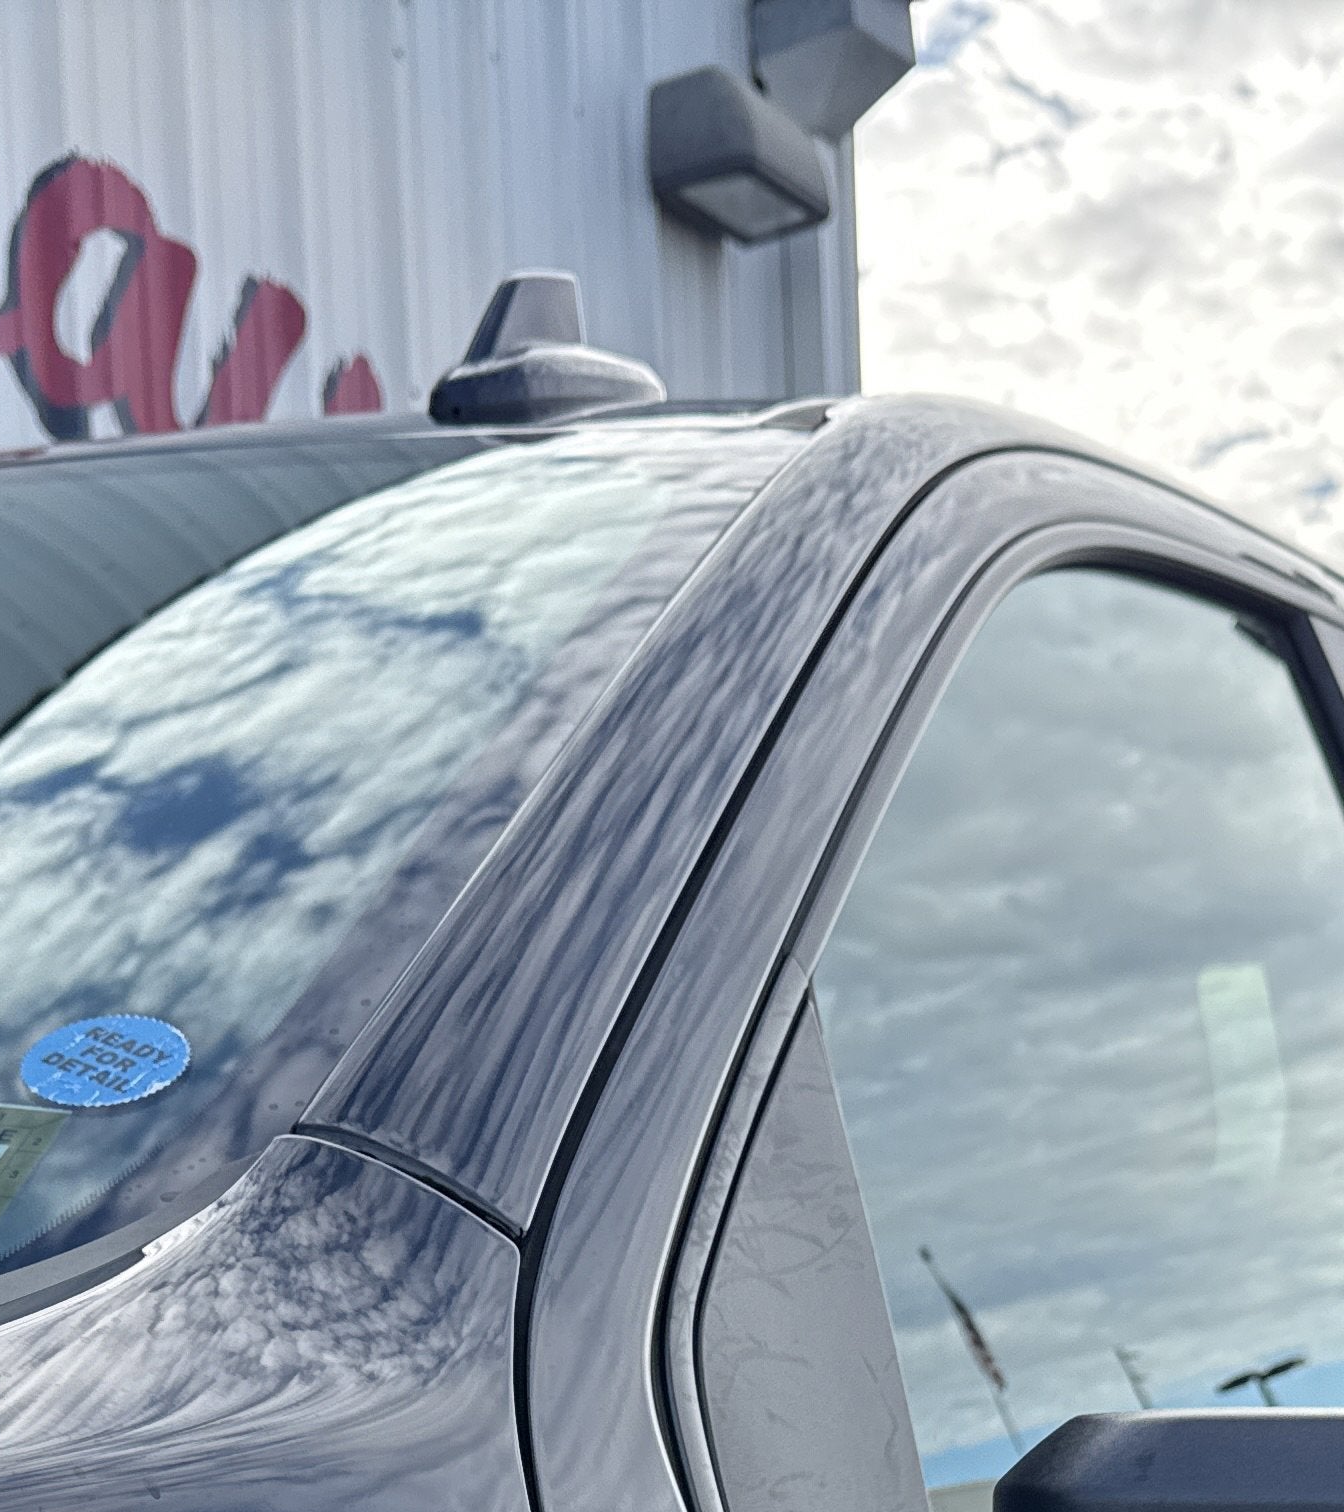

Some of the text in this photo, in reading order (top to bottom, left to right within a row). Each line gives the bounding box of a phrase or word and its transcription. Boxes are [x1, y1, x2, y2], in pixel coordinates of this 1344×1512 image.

[80, 1045, 136, 1073] FOR
[85, 1026, 173, 1064] READY
[41, 1051, 131, 1094] DETAIL
